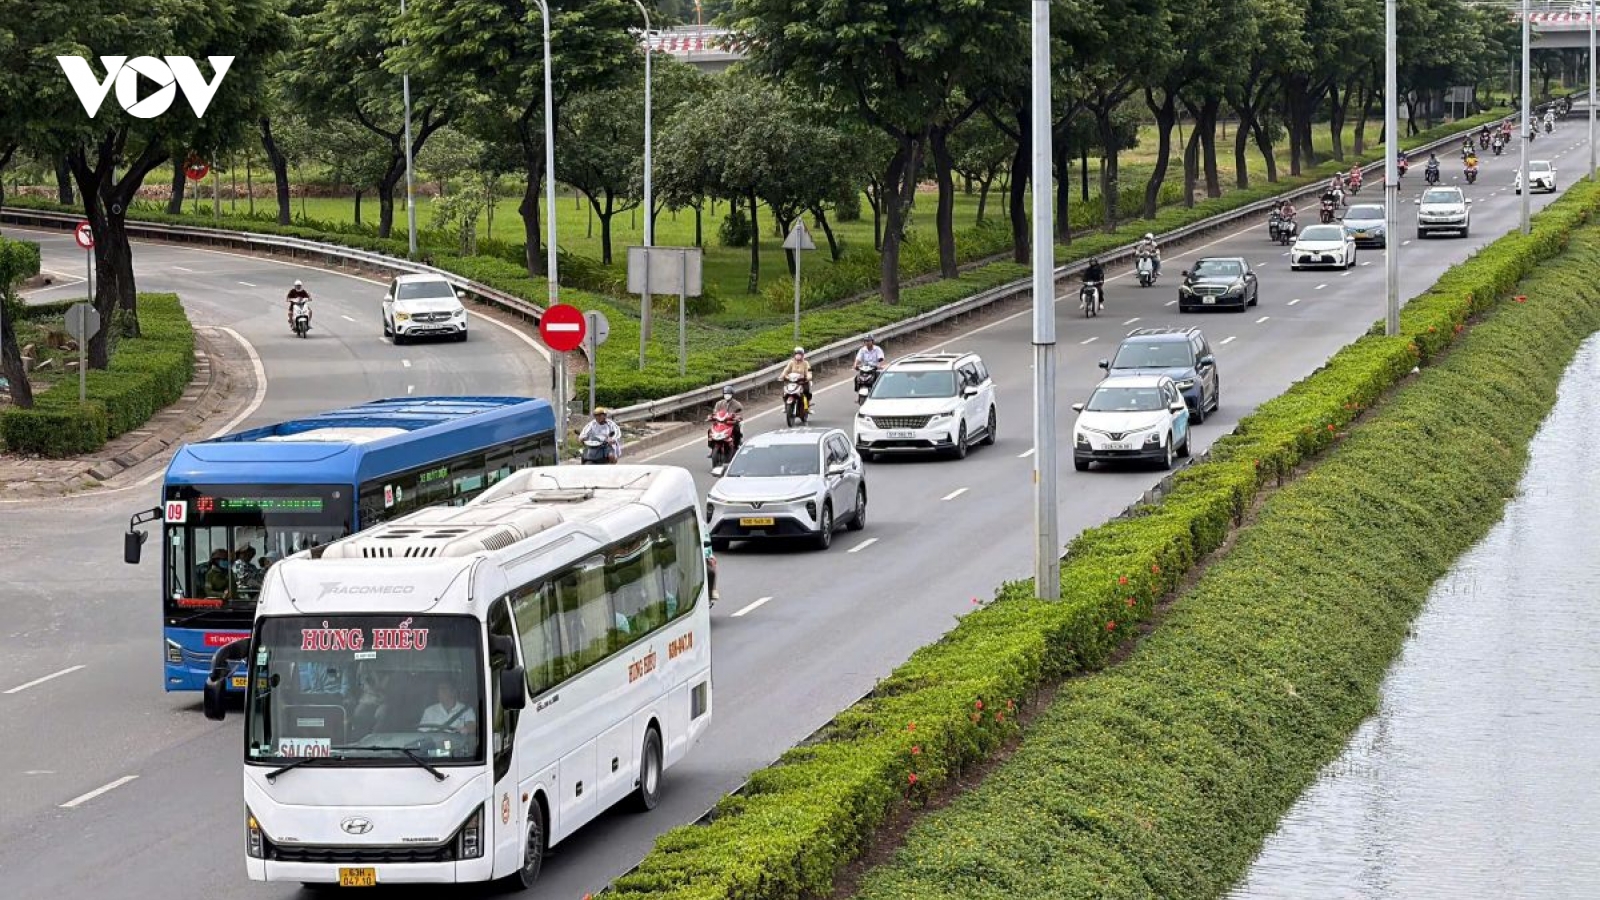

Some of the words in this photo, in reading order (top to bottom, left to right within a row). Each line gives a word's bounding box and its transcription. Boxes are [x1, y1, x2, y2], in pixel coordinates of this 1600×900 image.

[167, 503, 182, 520] 09
[317, 581, 415, 601] TRACOMECO
[372, 617, 429, 650] HIẾU
[303, 740, 329, 758] GÒN
[343, 876, 372, 886] 047.10
[348, 869, 365, 877] 63H
